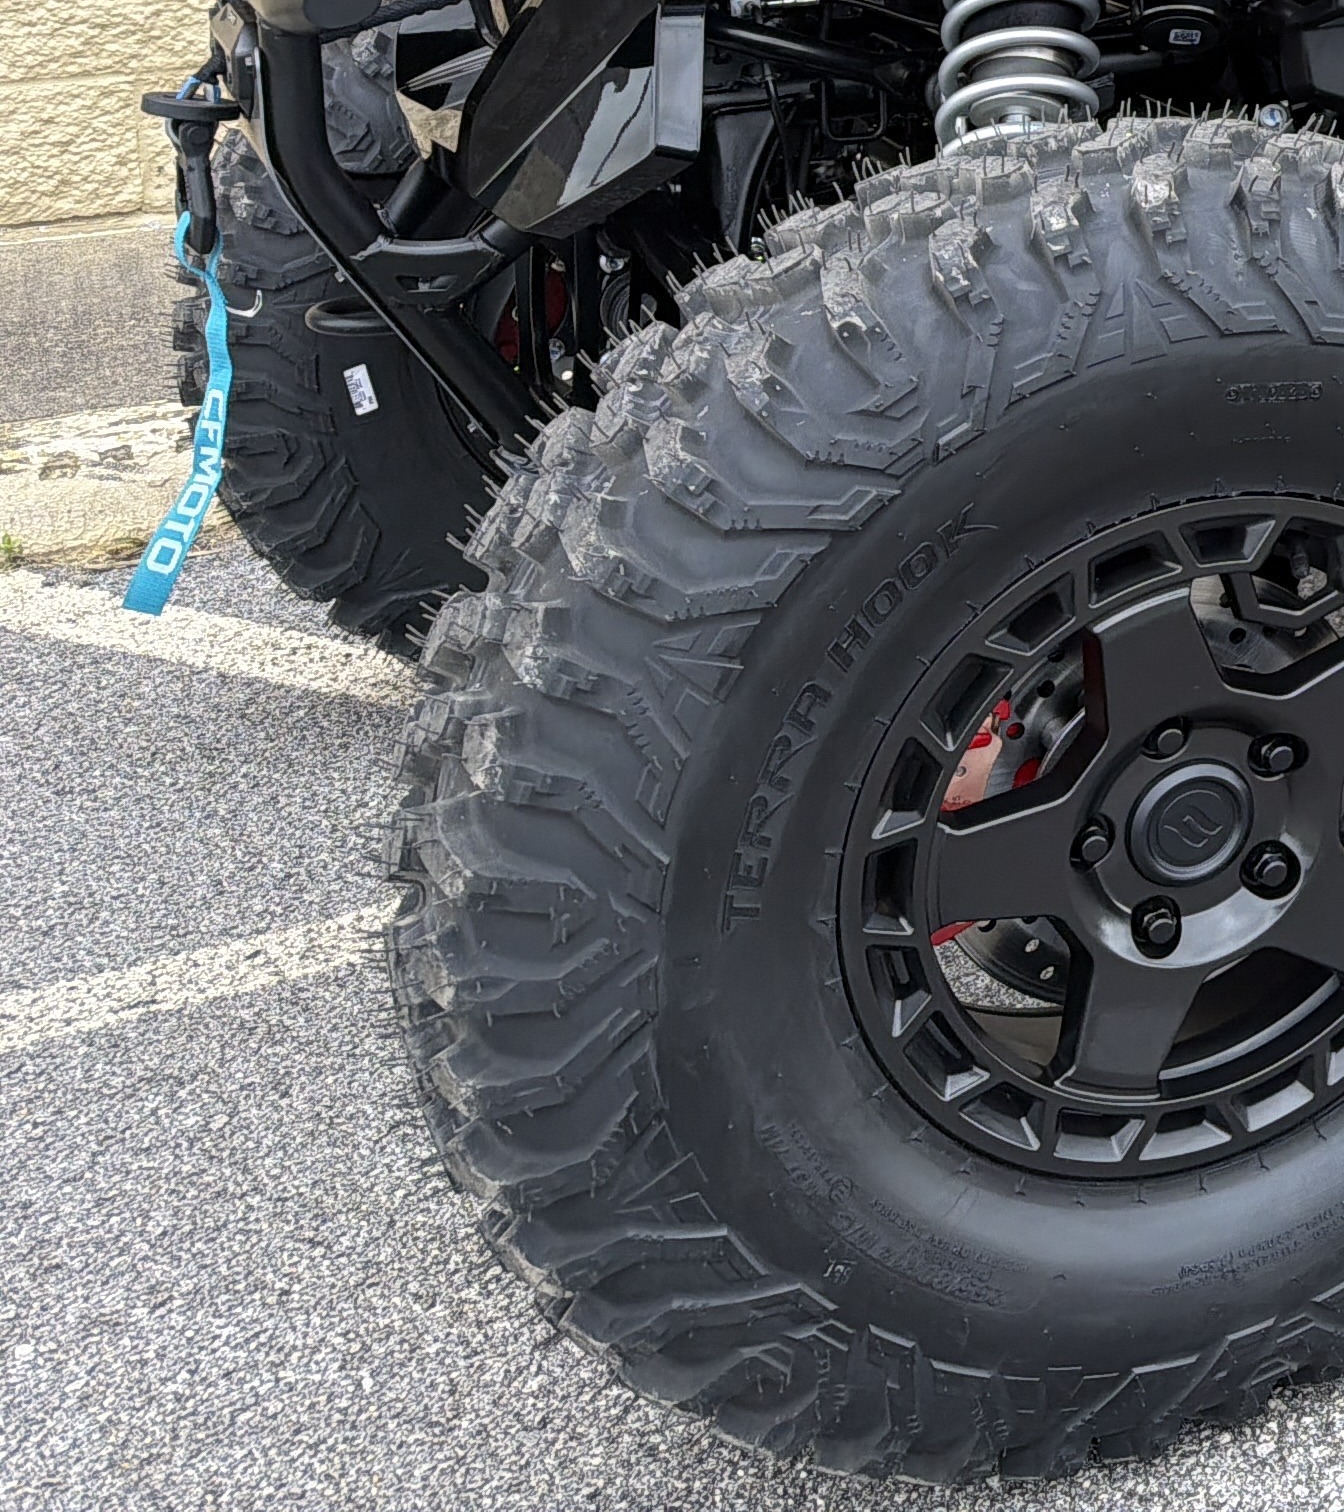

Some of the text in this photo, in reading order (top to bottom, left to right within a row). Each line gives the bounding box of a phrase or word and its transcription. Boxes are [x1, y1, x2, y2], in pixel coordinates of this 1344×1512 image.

[146, 389, 224, 575] CFMOTO
[718, 502, 999, 934] TERRA HOOK
